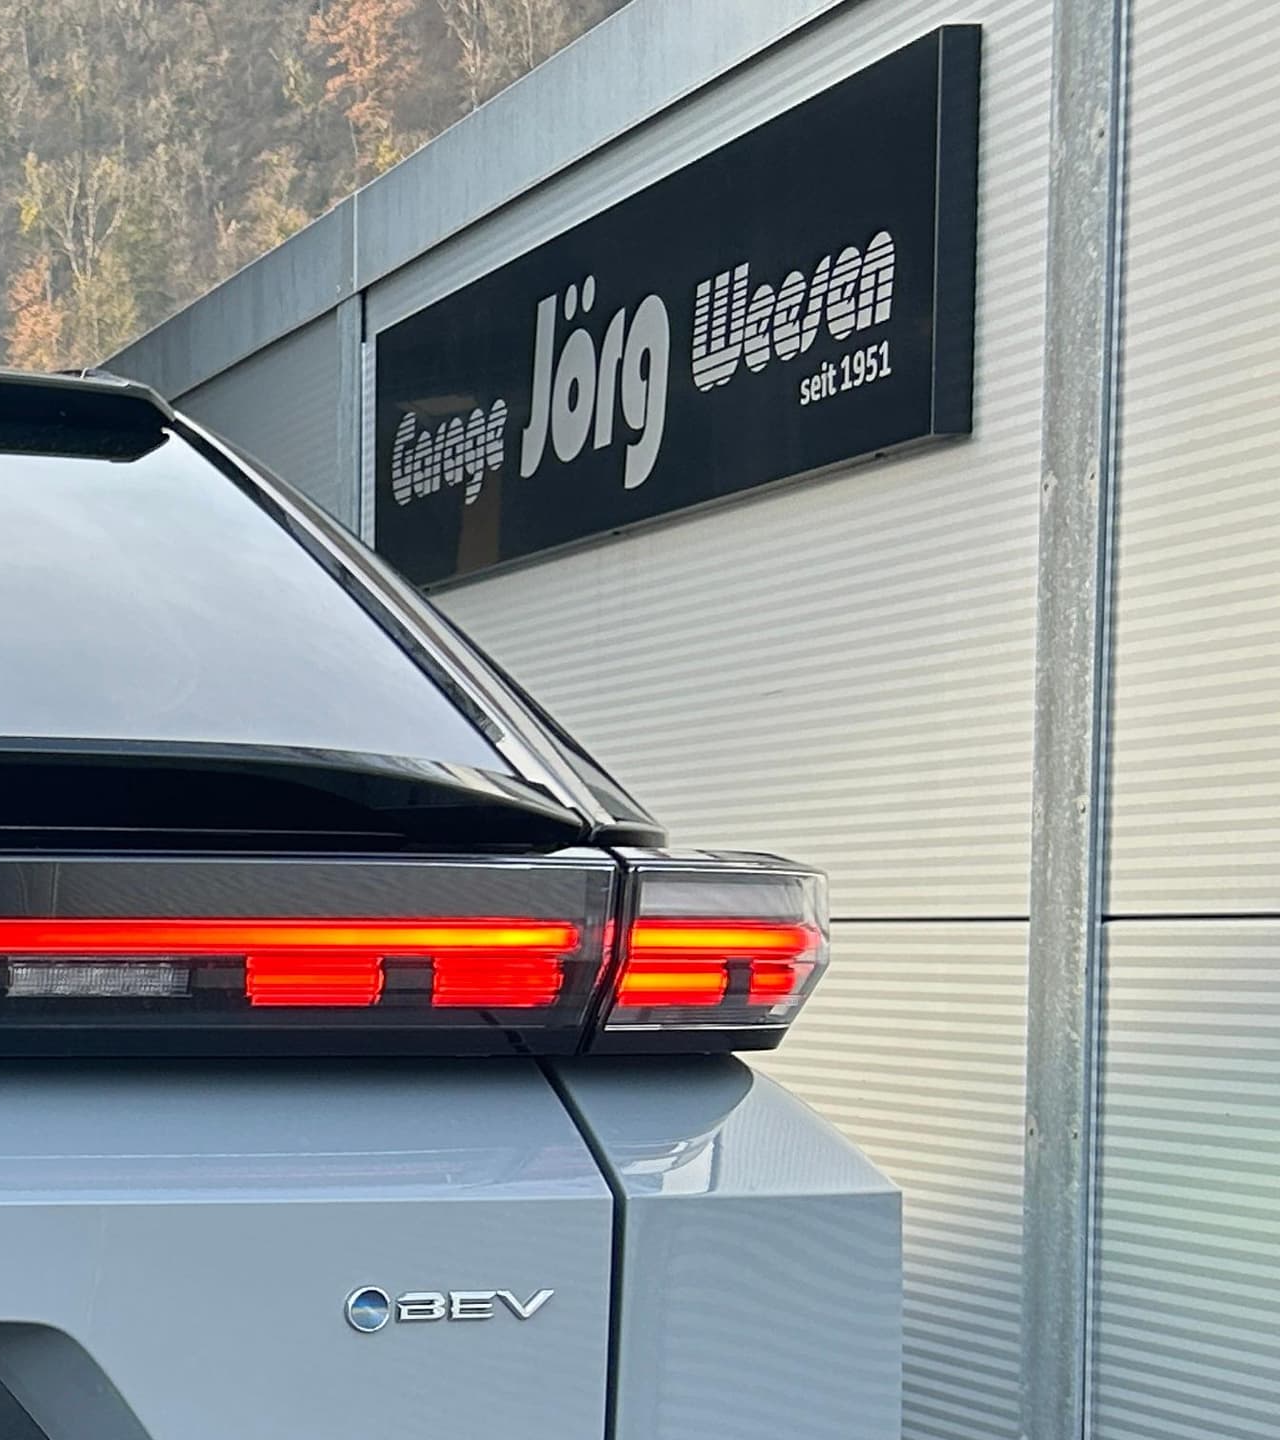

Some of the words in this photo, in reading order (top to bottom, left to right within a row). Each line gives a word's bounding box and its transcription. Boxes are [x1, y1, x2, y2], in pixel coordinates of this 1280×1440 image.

[391, 398, 508, 506] Garage
[520, 275, 671, 490] Jörg
[692, 231, 895, 392] Weesen
[800, 361, 837, 406] seit
[840, 340, 892, 391] 1951
[395, 1288, 555, 1322] BEV
